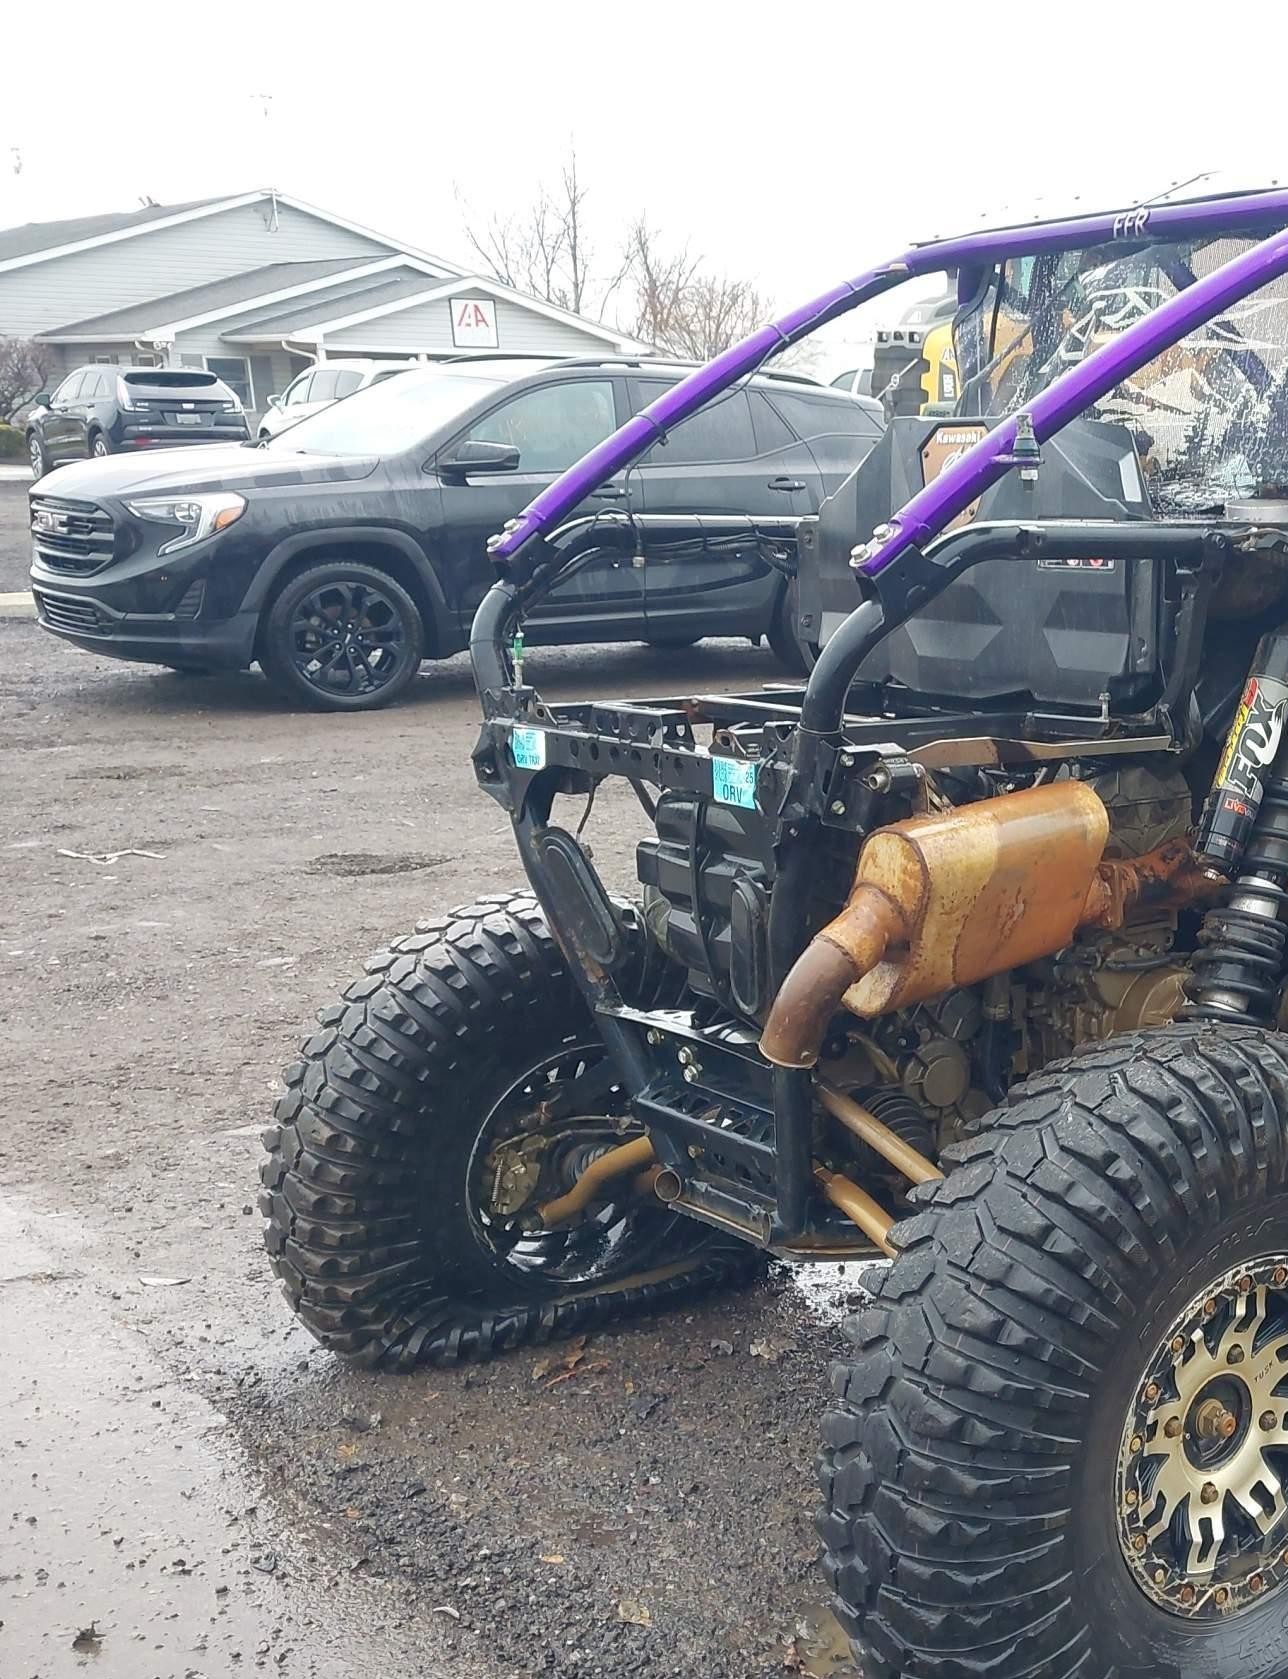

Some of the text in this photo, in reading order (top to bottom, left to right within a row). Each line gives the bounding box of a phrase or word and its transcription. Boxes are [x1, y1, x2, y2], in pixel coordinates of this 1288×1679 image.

[1113, 208, 1151, 238] FFR
[936, 431, 983, 445] Kawasaki
[1228, 687, 1288, 797] FOX
[745, 771, 754, 784] 25
[722, 783, 743, 804] ORV
[1253, 1360, 1273, 1383] TUSK
